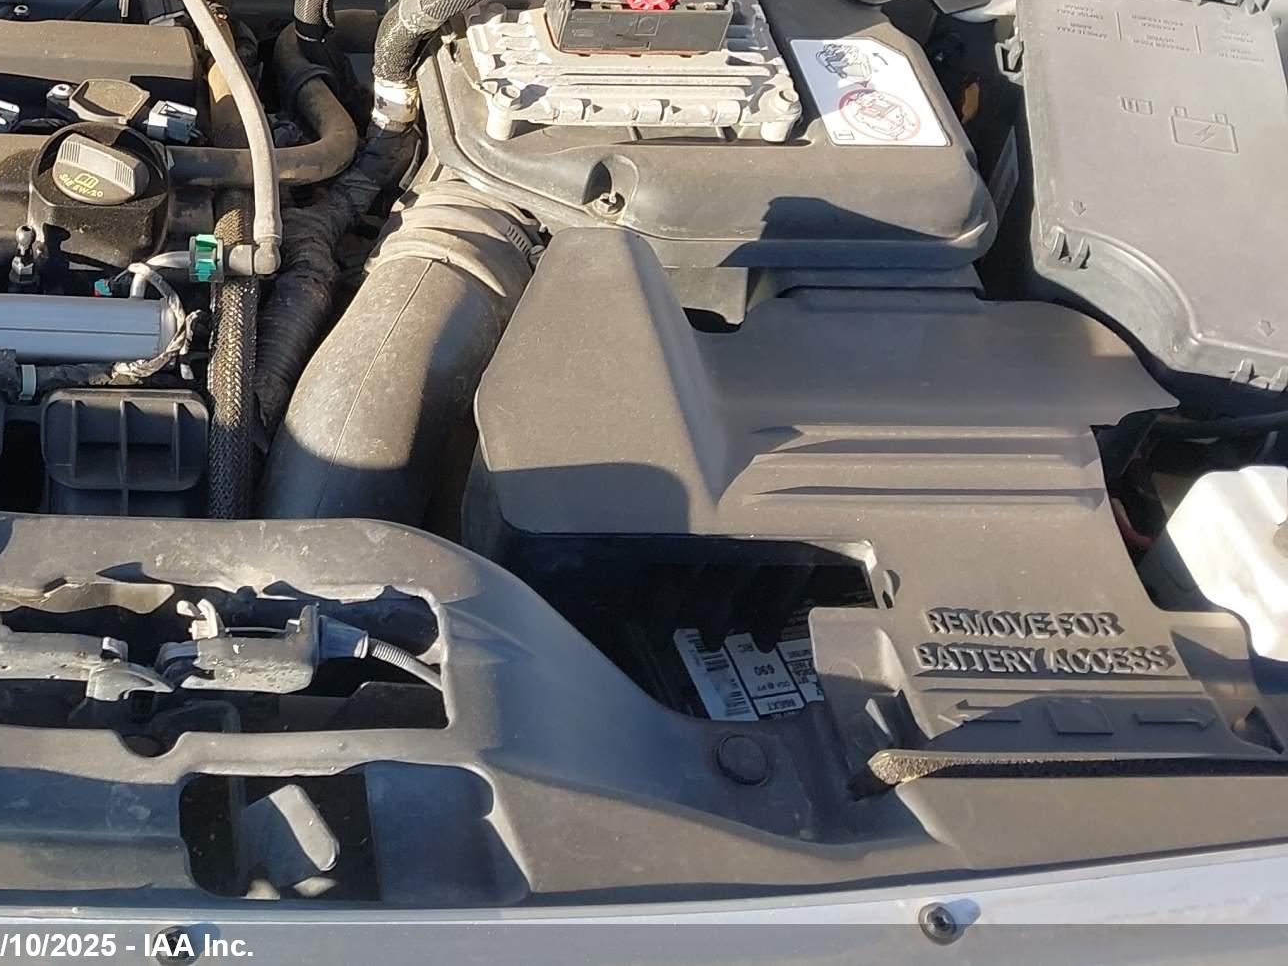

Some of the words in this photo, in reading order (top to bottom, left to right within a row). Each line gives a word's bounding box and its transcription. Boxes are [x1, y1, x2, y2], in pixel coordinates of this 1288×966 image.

[924, 607, 1050, 639] REMOVE
[1053, 610, 1124, 638] FOR
[914, 643, 1040, 673] BATTERY
[1050, 645, 1176, 674] ACCESS
